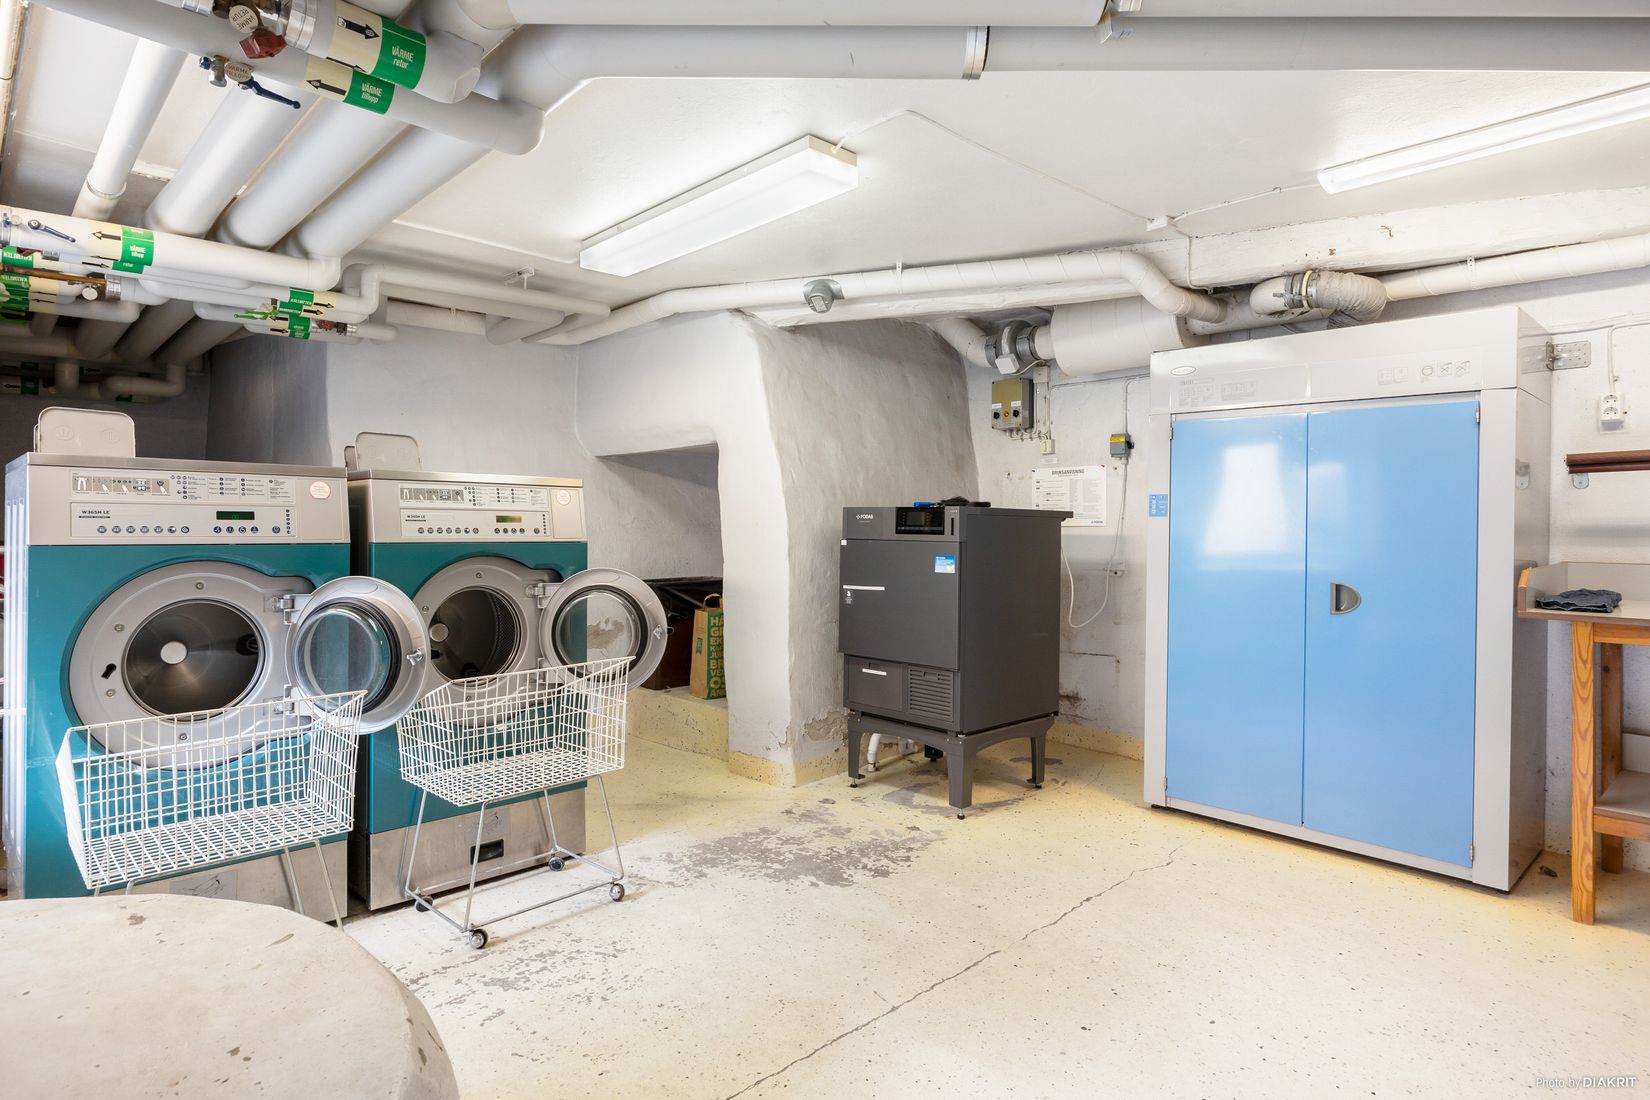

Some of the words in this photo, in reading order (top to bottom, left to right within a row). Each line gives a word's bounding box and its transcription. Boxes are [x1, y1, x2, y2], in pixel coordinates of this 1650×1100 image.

[391, 45, 414, 62] VÄRME
[392, 57, 409, 69] retur
[361, 82, 383, 97] VÄRME
